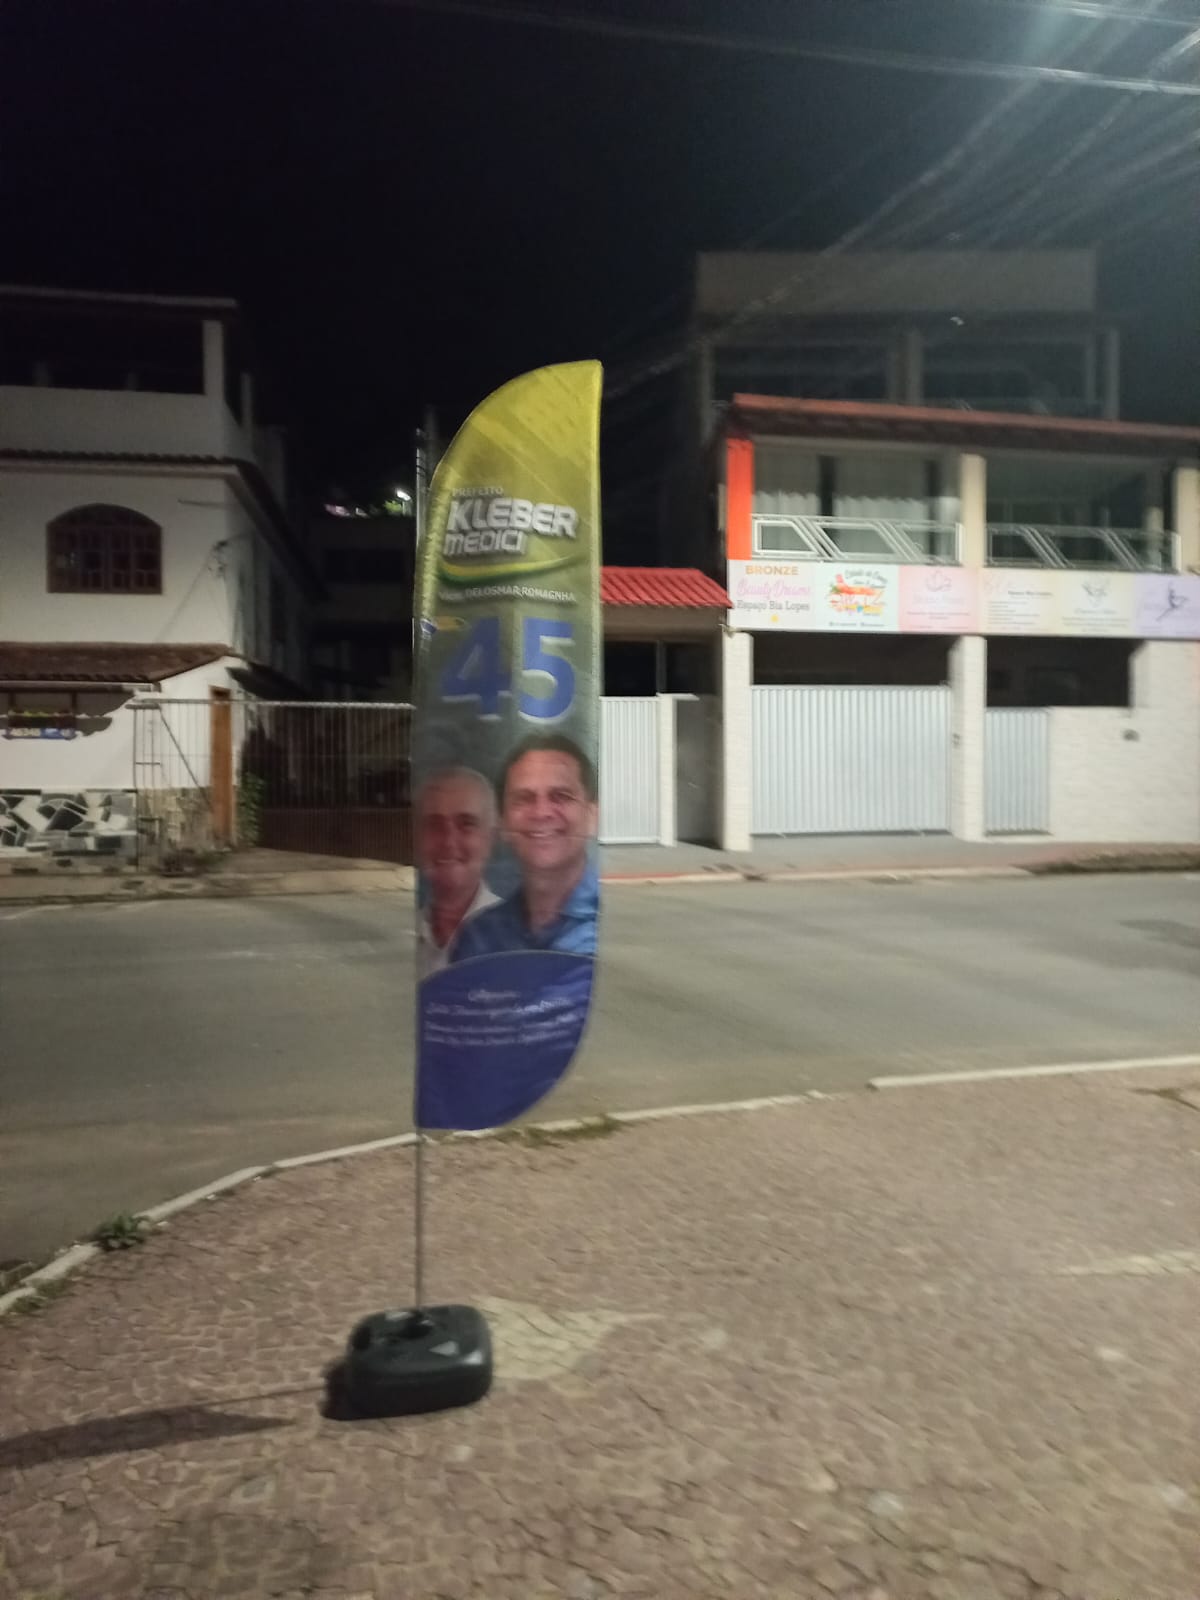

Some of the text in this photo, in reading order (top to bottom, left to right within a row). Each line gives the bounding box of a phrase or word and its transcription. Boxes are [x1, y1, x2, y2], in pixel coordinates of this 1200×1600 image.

[448, 498, 577, 538] KLEBER
[444, 530, 527, 555] MEDICI
[746, 565, 798, 576] BRONZE
[737, 600, 767, 612] Espaço
[786, 600, 811, 613] Lopes
[441, 616, 576, 723] 45
